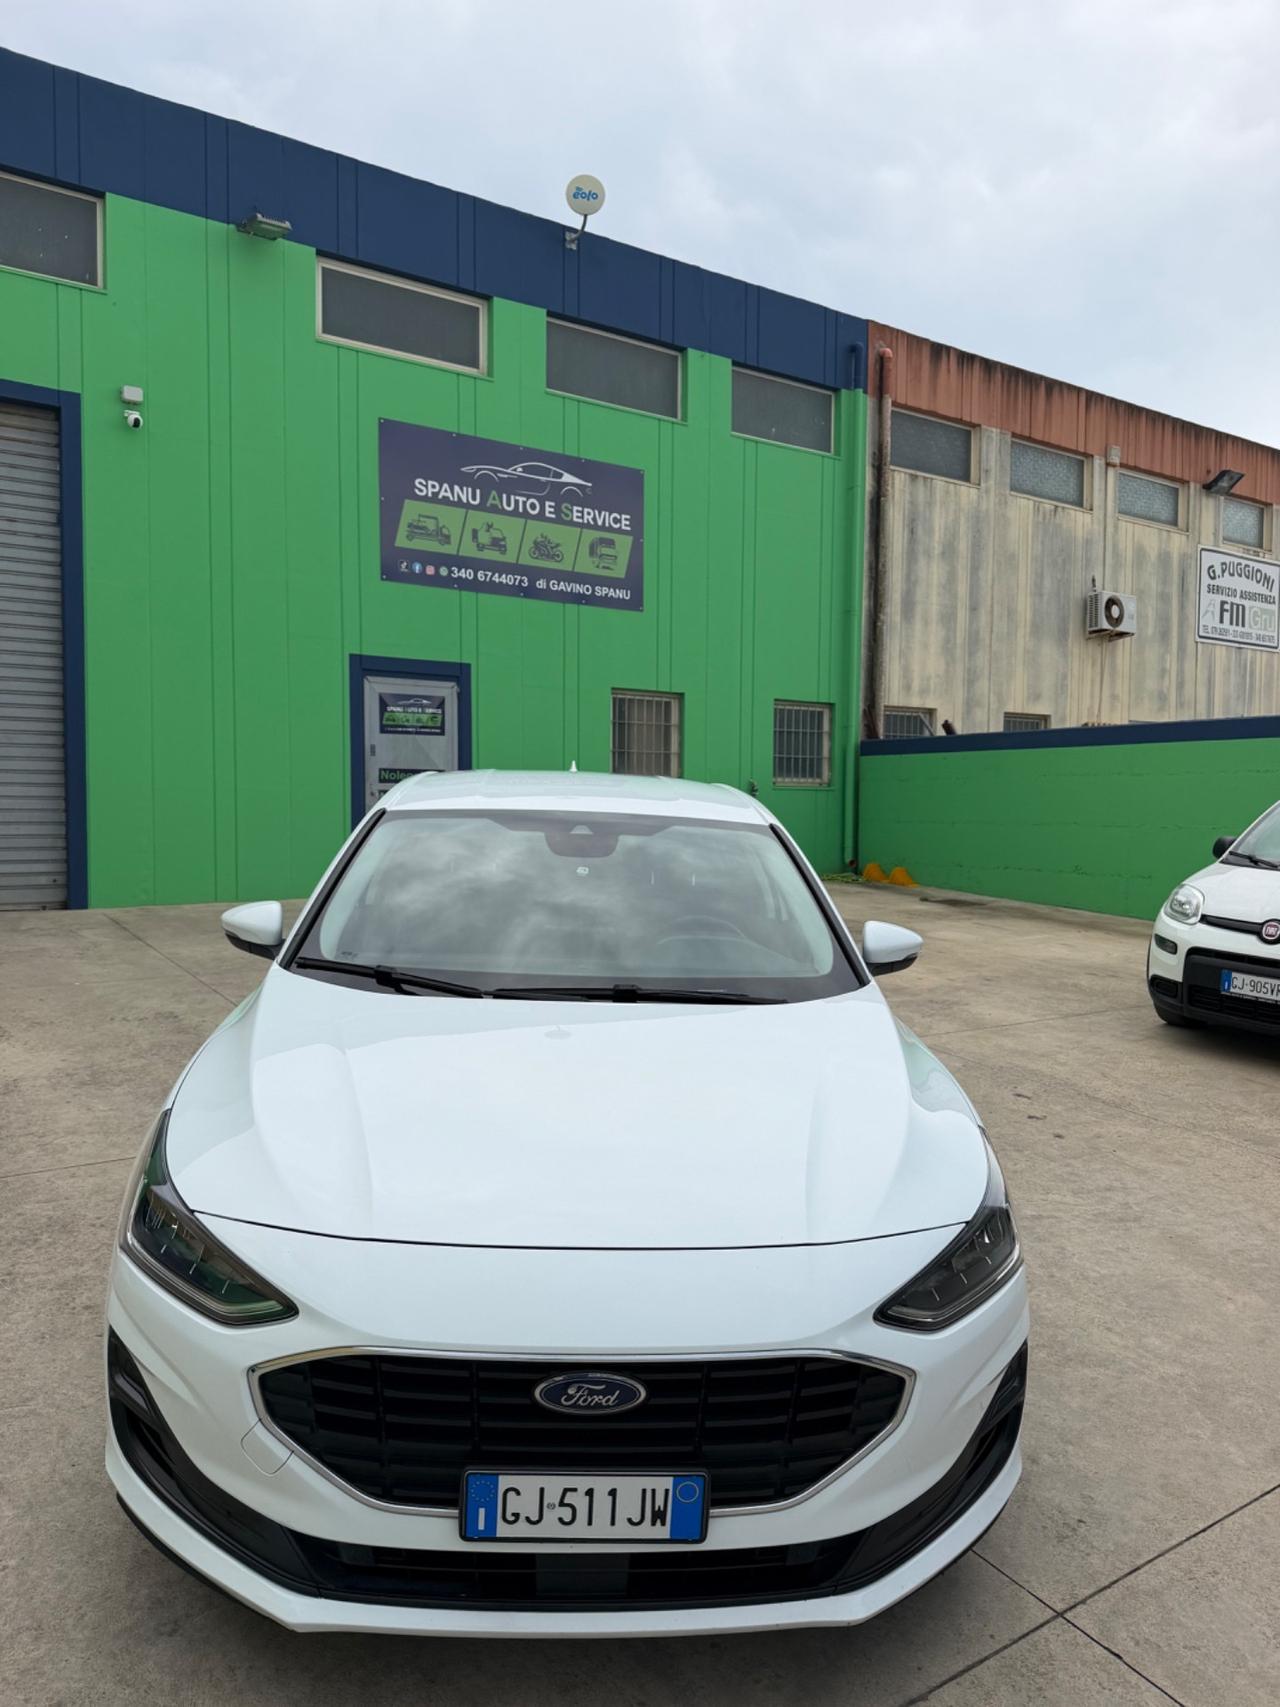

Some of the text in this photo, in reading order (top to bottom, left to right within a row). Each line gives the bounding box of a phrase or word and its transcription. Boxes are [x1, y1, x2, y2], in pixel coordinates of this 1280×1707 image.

[413, 477, 632, 531] SPANU AUTO E SERVICE
[450, 566, 631, 601] 340 6744073 di GAVINO SPANU
[1206, 583, 1276, 605] SERVIZIO ASSISTENZA
[560, 1383, 620, 1407] Ford
